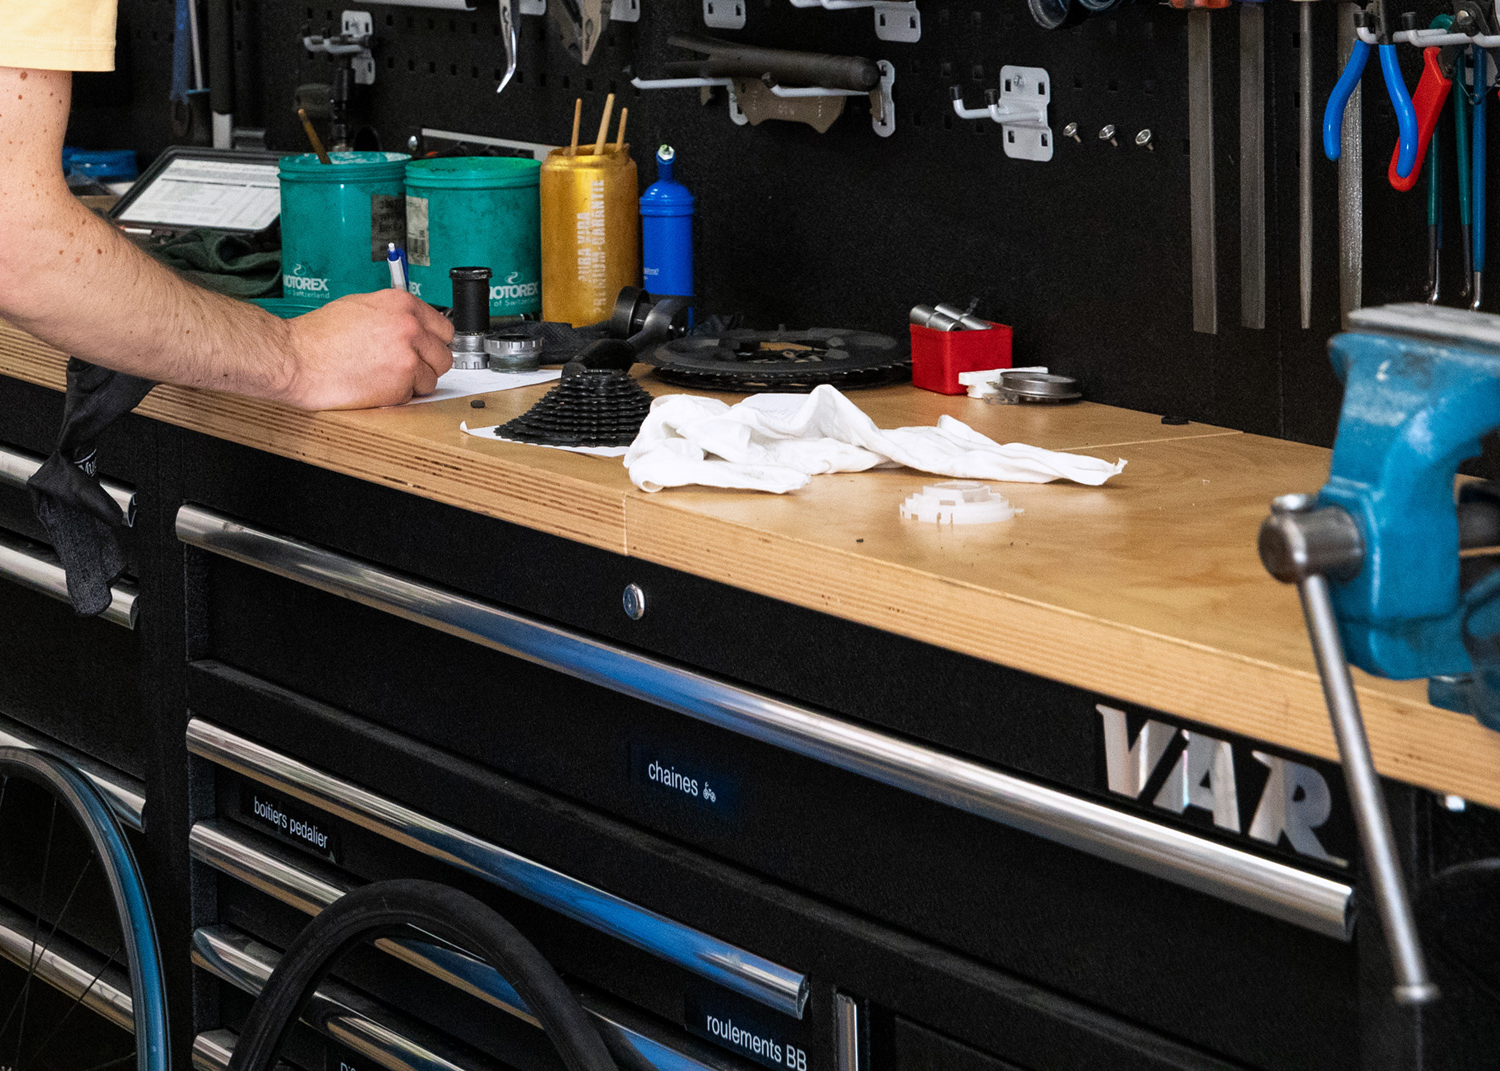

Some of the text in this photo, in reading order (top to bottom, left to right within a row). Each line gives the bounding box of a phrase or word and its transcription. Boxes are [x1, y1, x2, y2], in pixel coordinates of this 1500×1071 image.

[648, 760, 699, 797] chaines
[1096, 704, 1349, 868] VAR
[254, 795, 328, 849] boitiers pedalier
[706, 1015, 807, 1071] roulements BB
